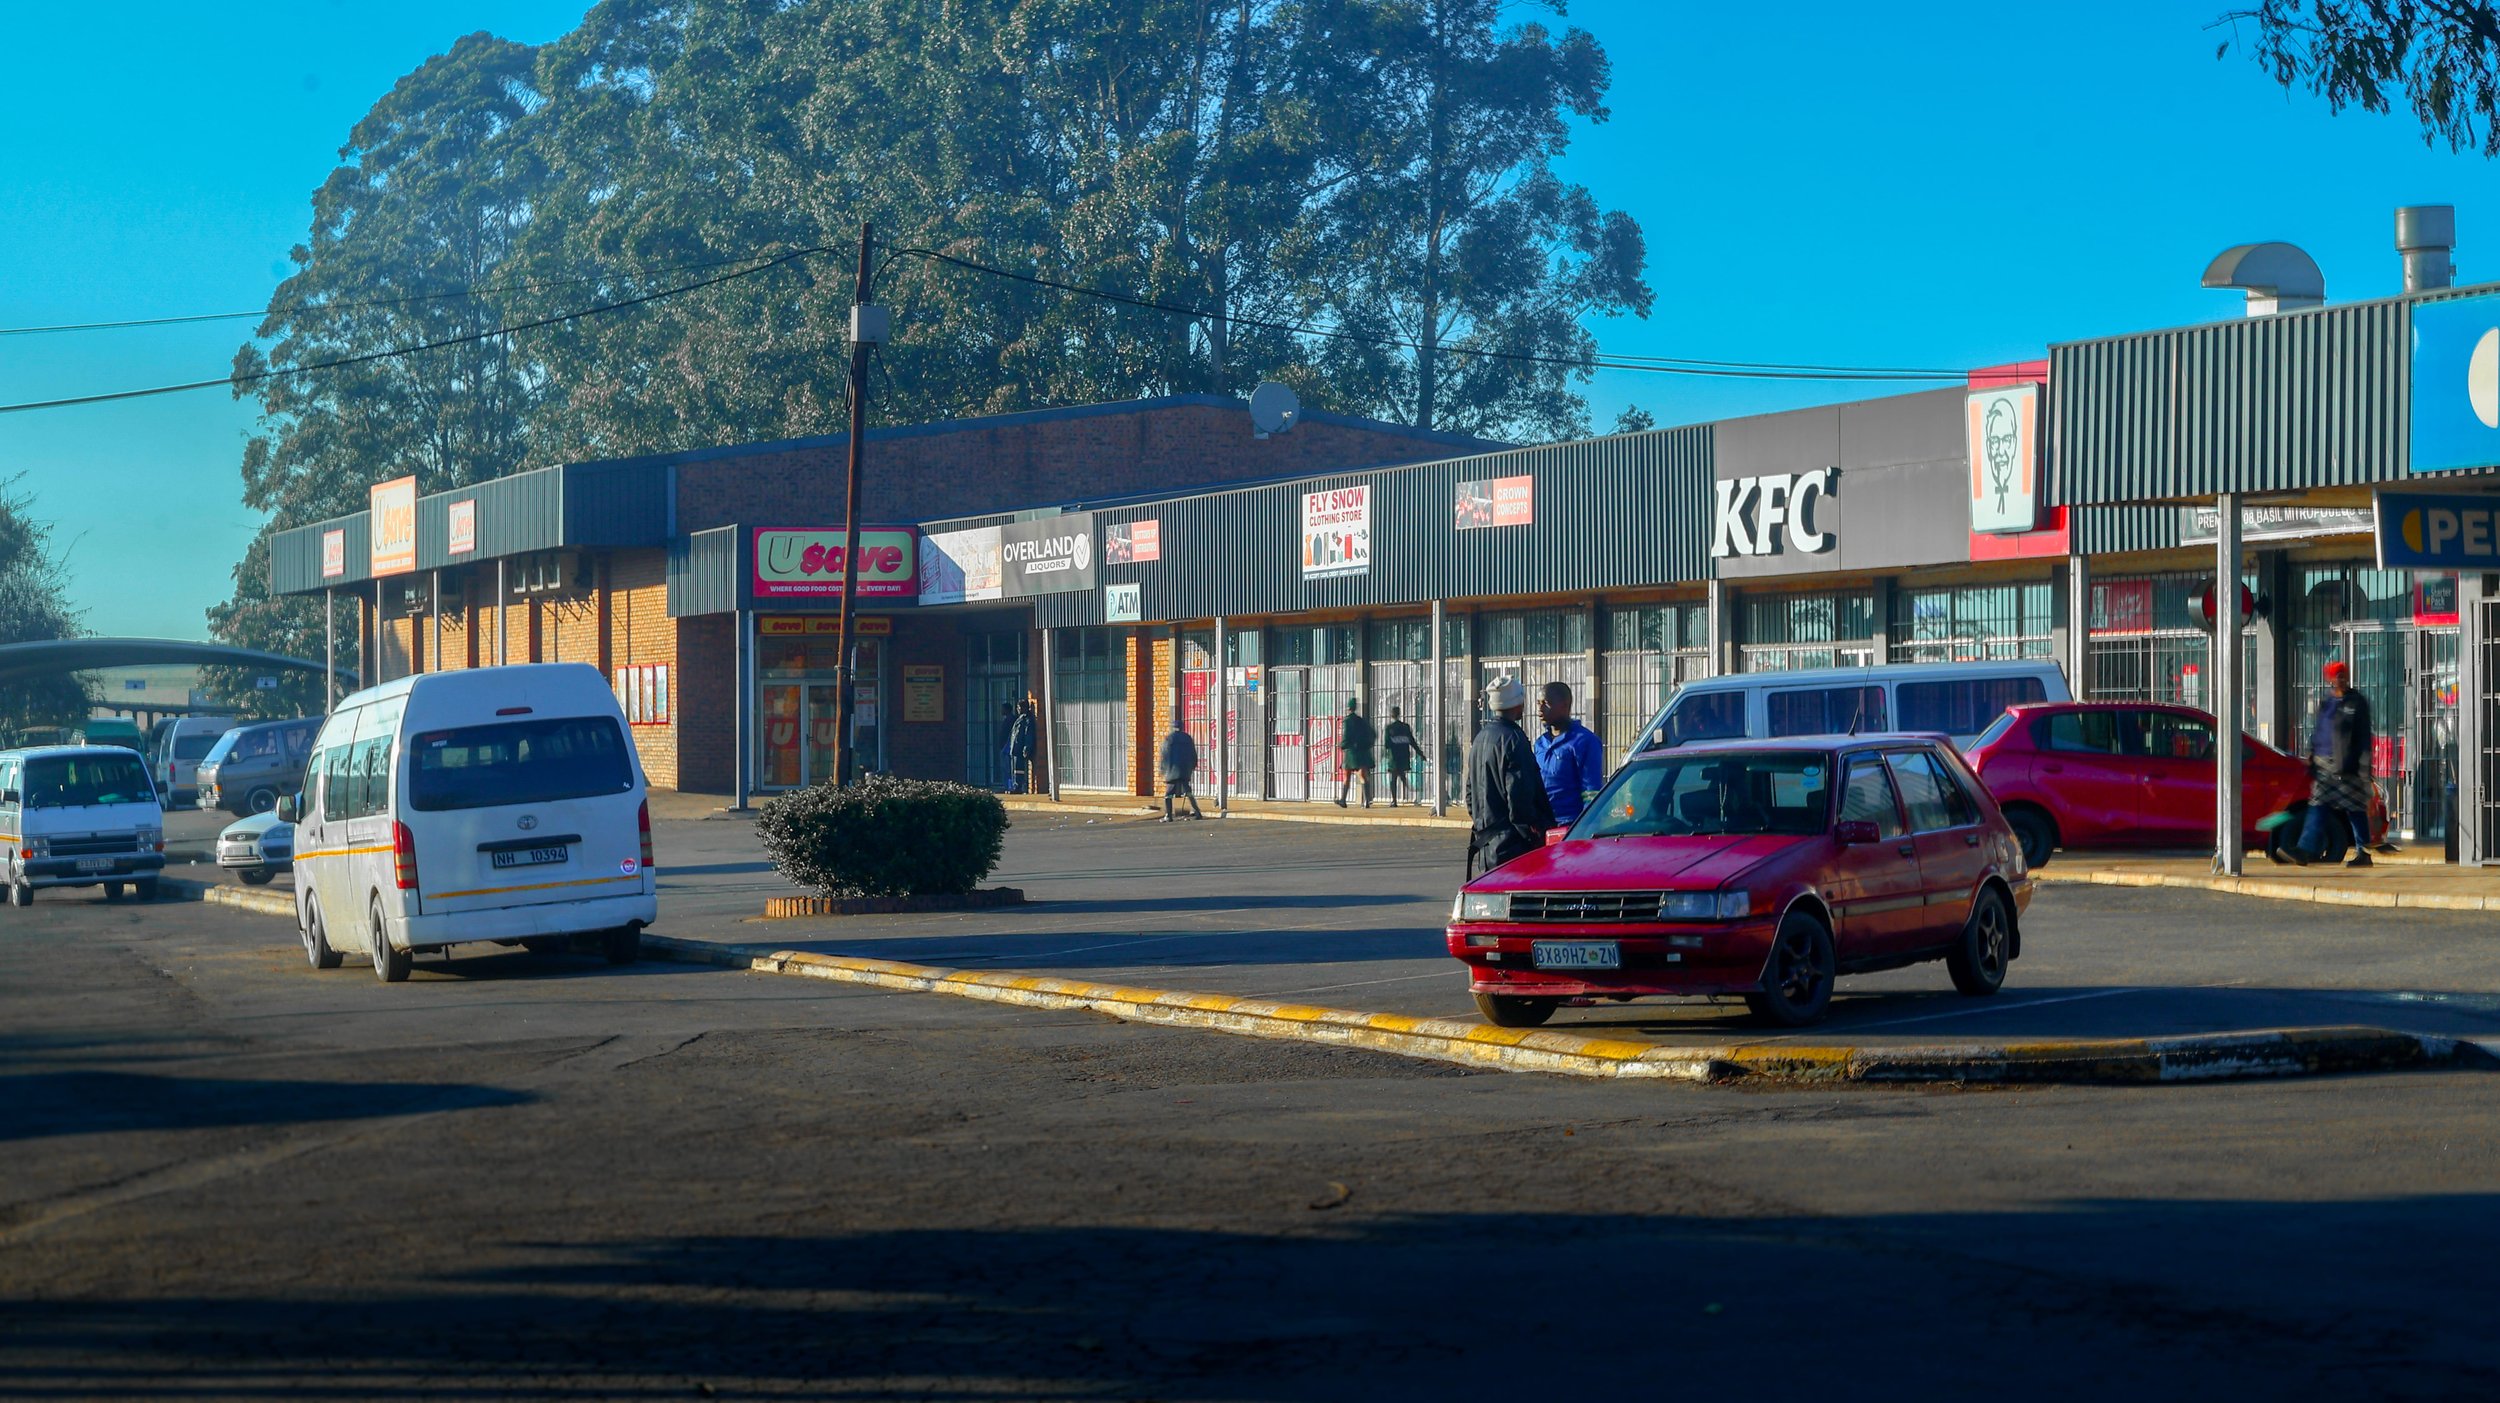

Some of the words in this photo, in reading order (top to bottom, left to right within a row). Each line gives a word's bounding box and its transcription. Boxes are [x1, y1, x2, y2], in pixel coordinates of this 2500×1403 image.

[1309, 493, 1328, 513] FLY
[1332, 487, 1365, 510] SNOW
[1496, 486, 1528, 500] CROWN
[1496, 502, 1528, 516] CONCEPTS
[1711, 469, 1827, 557] KFC
[2256, 507, 2283, 524] BASIL
[1309, 512, 1340, 527] CLOTHING
[1342, 510, 1362, 523] STORE
[2427, 508, 2500, 556] PE
[1003, 535, 1074, 563] OVERLAND
[1030, 560, 1066, 572] LIQUORS
[770, 585, 792, 593] WHERE
[793, 585, 810, 593] GOOD
[811, 585, 827, 593] FOOD
[828, 585, 843, 593] COST
[1118, 592, 1139, 614] ATM
[496, 853, 515, 865] NH
[530, 849, 565, 863] 10394
[1566, 903, 1596, 911] TOYOTA
[1536, 946, 1588, 965] BX89HZ
[1599, 946, 1617, 965] ZN
